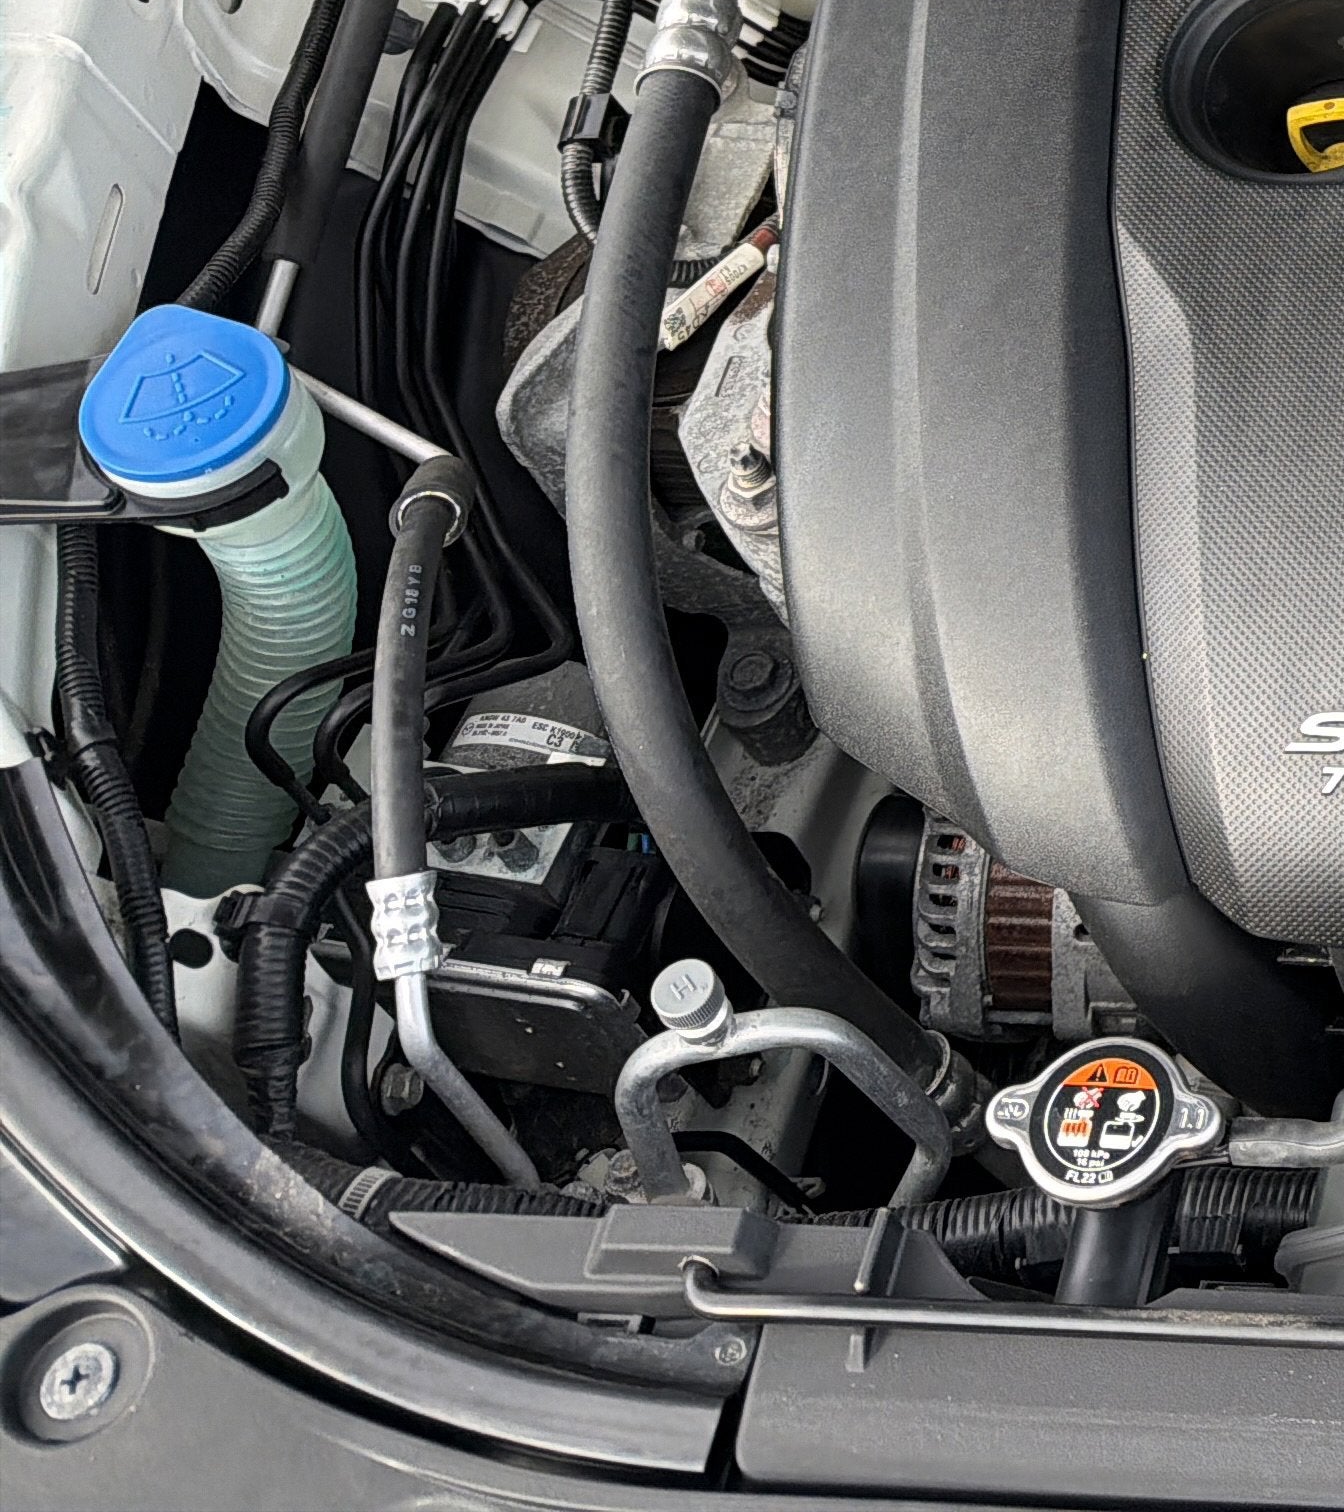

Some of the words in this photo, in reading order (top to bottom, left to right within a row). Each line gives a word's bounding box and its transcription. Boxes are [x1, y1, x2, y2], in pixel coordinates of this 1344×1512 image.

[532, 722, 549, 731] ESC
[546, 733, 564, 747] C3
[669, 973, 698, 1001] H
[1064, 1169, 1097, 1184] FL22
